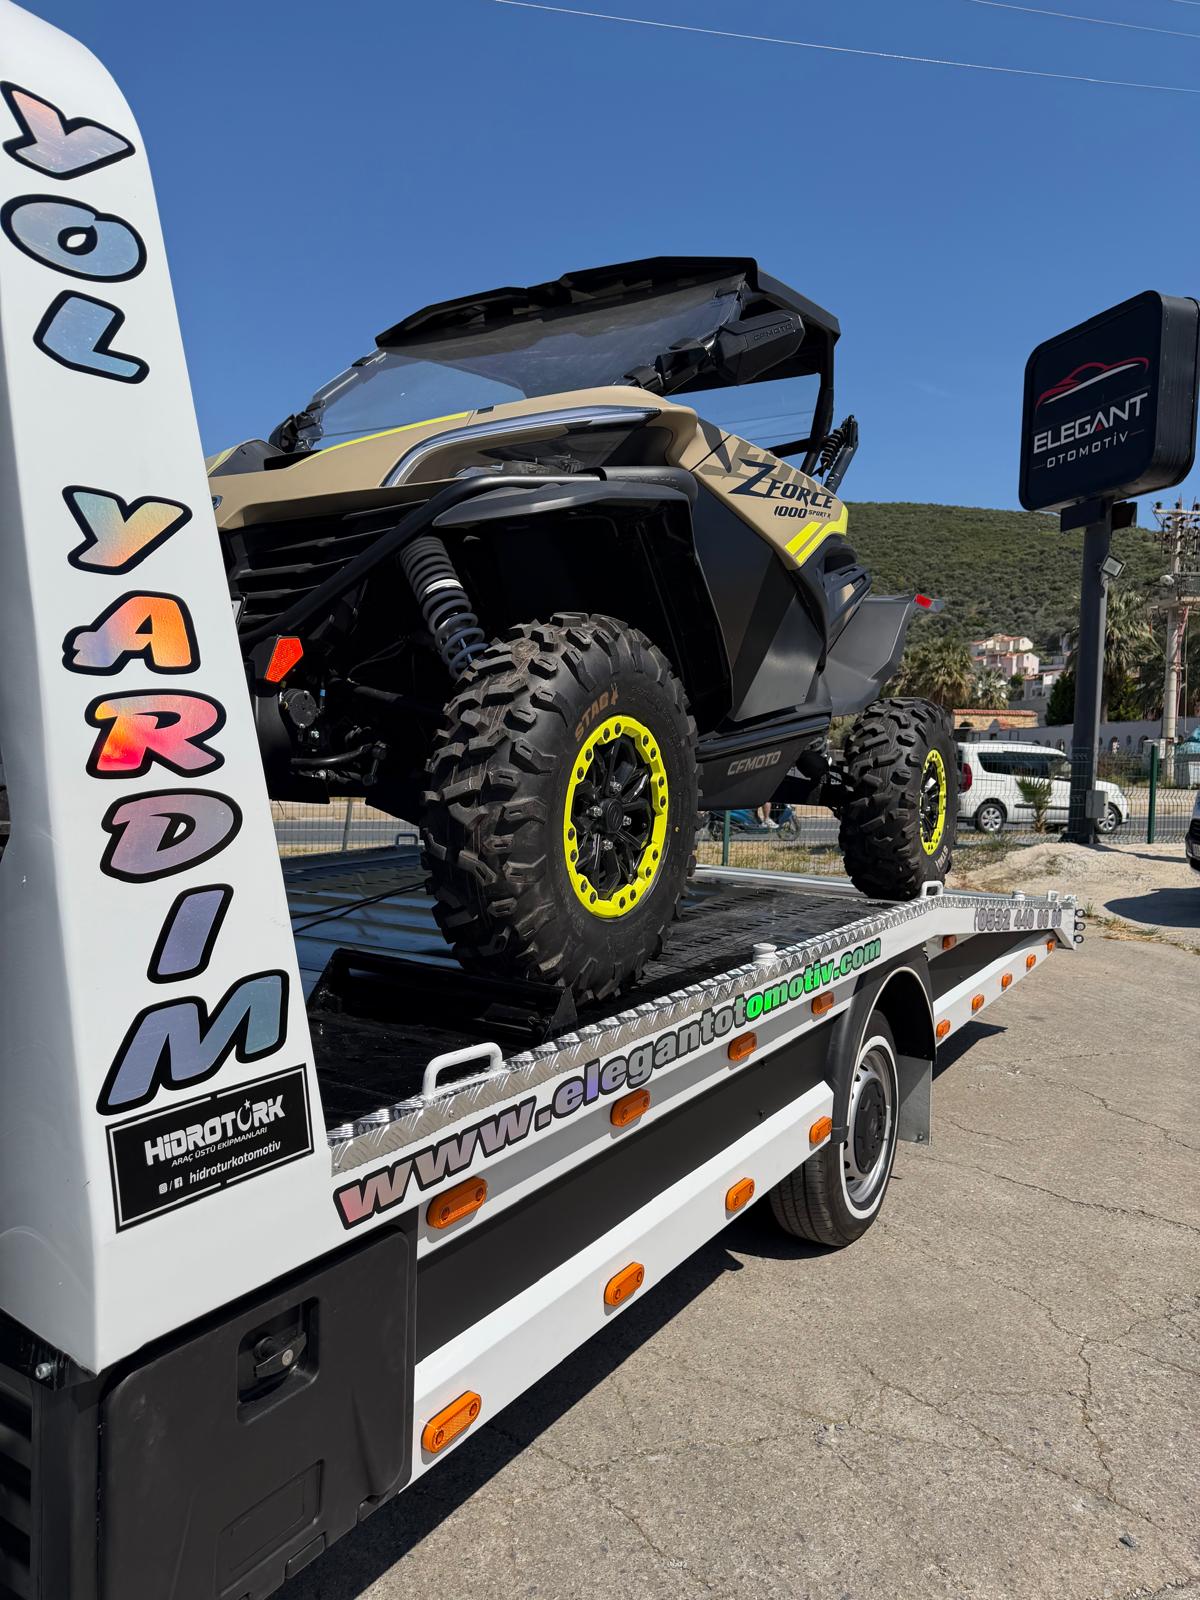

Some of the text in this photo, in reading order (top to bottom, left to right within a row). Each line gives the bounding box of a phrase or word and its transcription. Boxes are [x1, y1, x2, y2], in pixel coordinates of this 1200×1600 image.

[1033, 392, 1148, 454] ELEGANT
[773, 505, 807, 519] 1000
[808, 510, 826, 518] SPORT
[0, 80, 291, 1115] YOL YARDIM
[727, 750, 782, 776] CFMOTO
[977, 907, 1011, 932] 0532
[334, 937, 882, 1230] www.elegantotomotiv.com
[171, 1126, 268, 1168] ARAÇ ÜSTÜ EKİPMANLARI
[189, 1139, 281, 1185] hidroturkotomotiv
